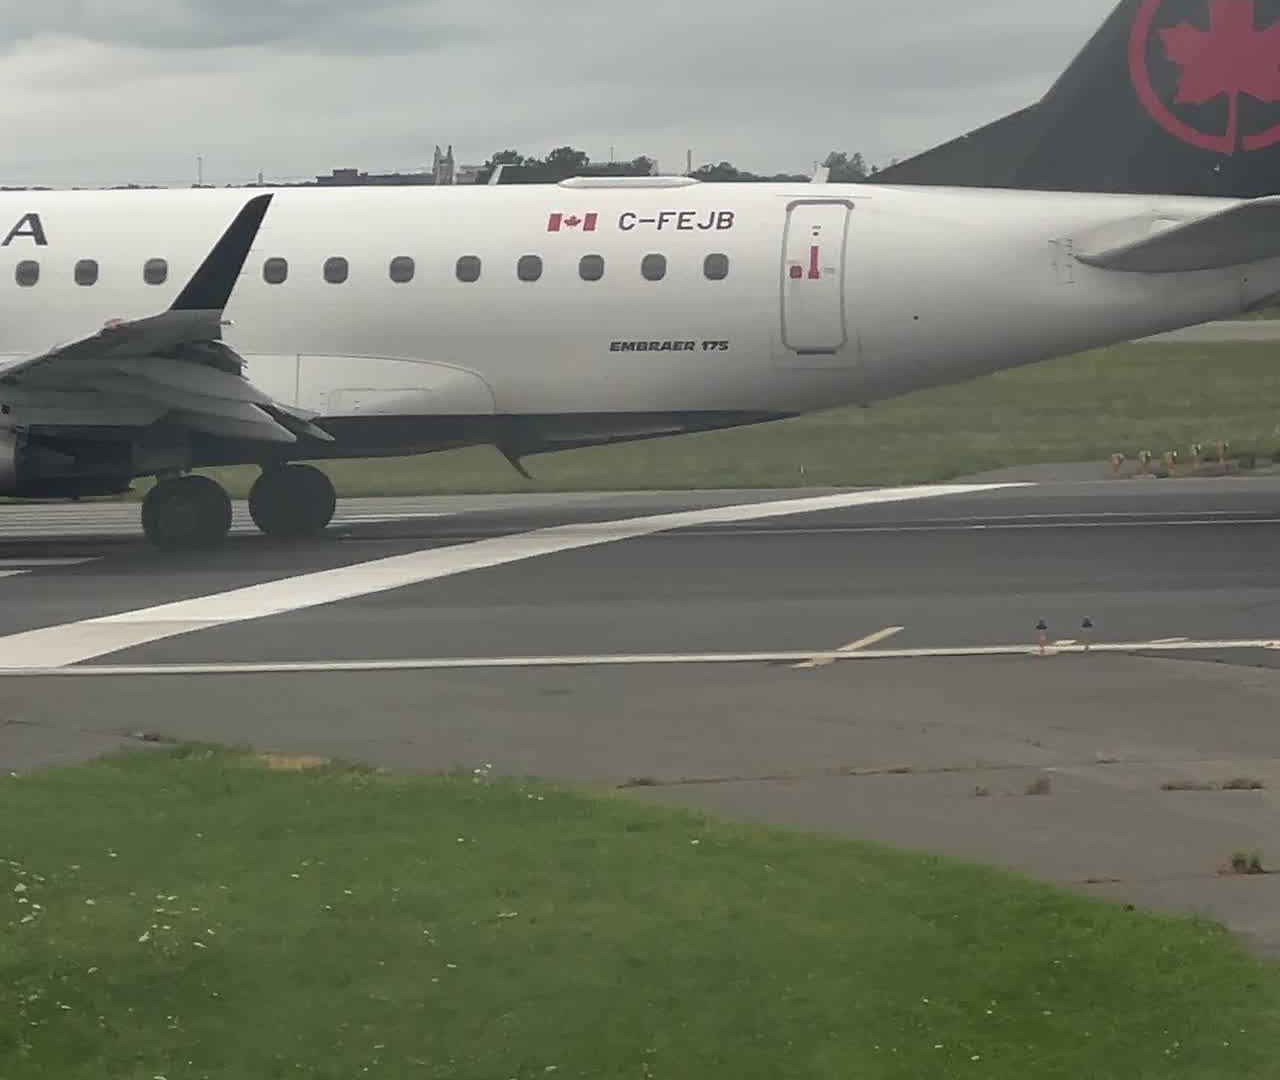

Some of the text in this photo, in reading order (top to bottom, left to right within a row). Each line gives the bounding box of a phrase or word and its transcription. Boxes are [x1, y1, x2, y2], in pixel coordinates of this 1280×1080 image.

[618, 211, 735, 231] C-FEJB
[609, 340, 729, 352] EMBRAER 175
